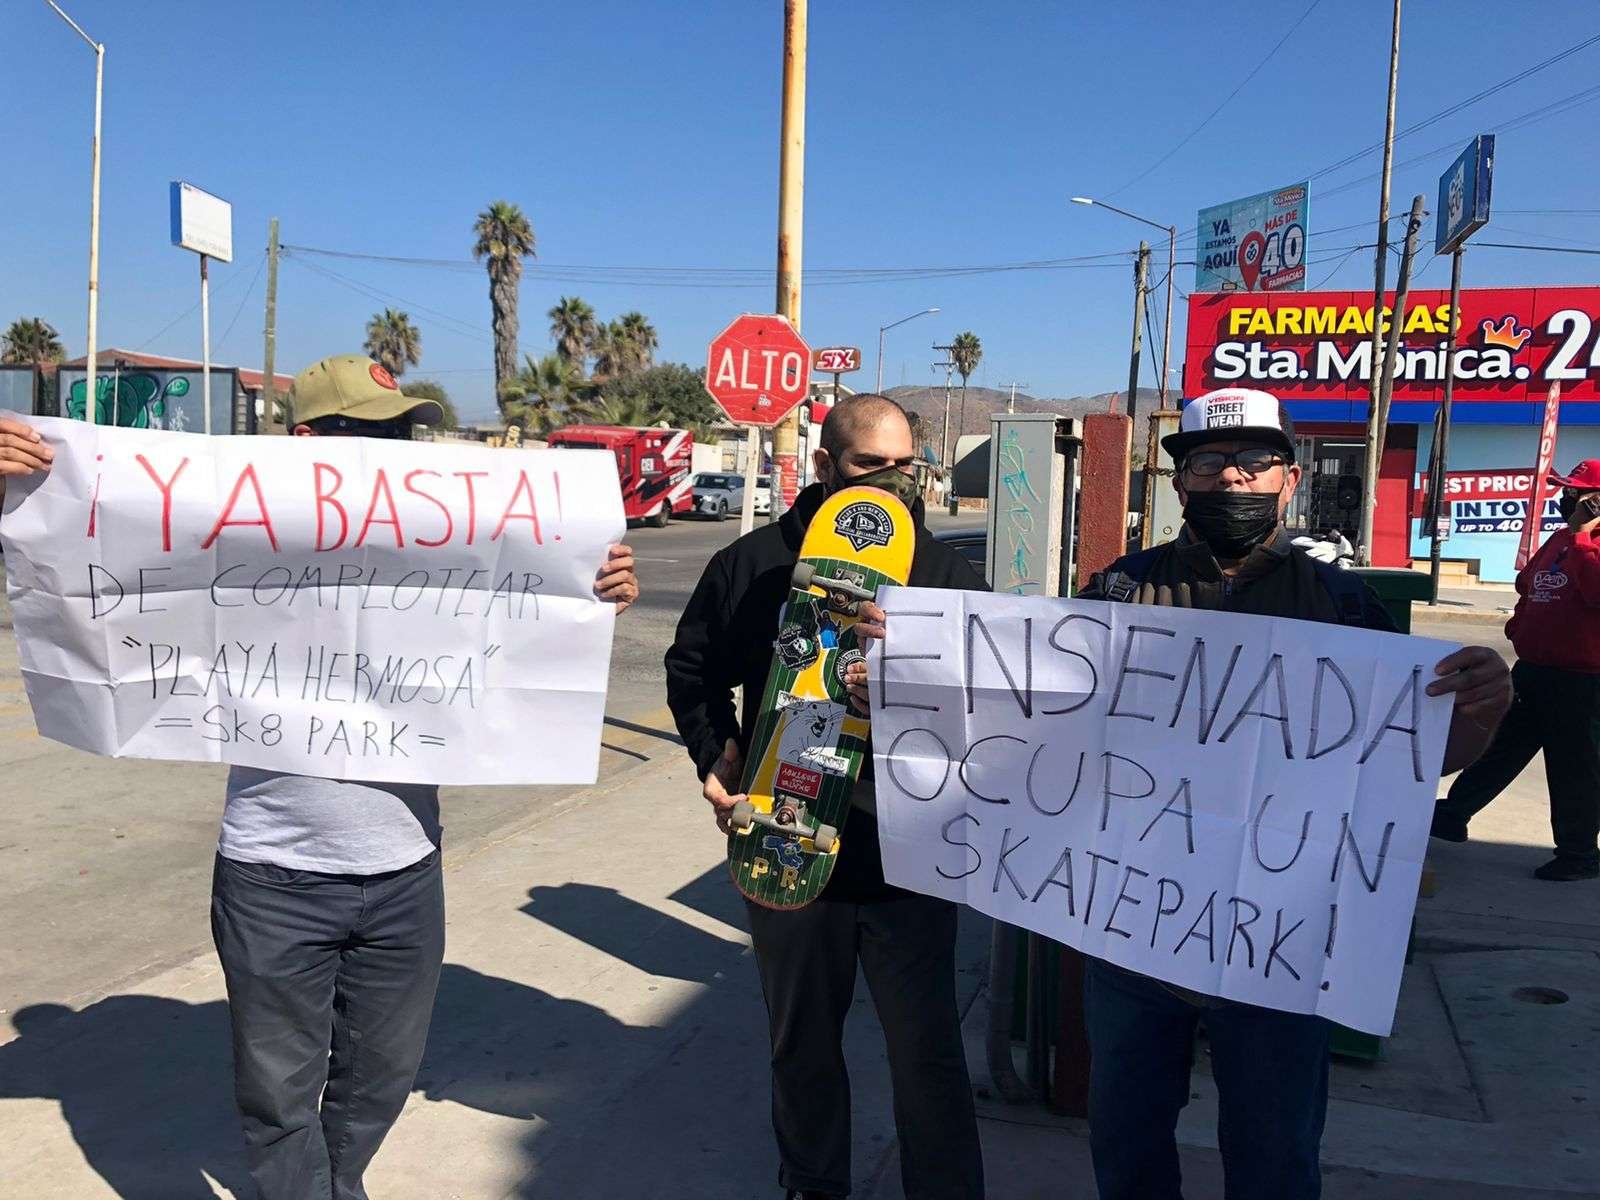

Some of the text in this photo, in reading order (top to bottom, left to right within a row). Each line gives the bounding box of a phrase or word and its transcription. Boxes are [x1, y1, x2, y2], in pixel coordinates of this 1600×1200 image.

[1213, 220, 1230, 236] YA
[1265, 210, 1297, 231] MÁS DE
[1206, 236, 1236, 249] ESTAMOS
[1260, 224, 1304, 276] 40
[1203, 246, 1238, 271] AQUÍ
[1269, 269, 1304, 288] FARMACIAS
[1229, 305, 1461, 335] FARMACAS
[1213, 341, 1309, 379] Sta.
[1545, 310, 1600, 380] 2
[714, 347, 802, 392] ALTO
[1207, 402, 1245, 415] STREET
[1209, 414, 1242, 428] WEAR
[314, 462, 564, 553] BASTA!
[1456, 501, 1481, 518] IN
[1460, 524, 1476, 532] UP
[1478, 523, 1494, 532] TO
[86, 563, 544, 621] DE COMPLOTEAR
[880, 610, 1425, 782] ENSENADA
[886, 727, 1395, 893] OCUPA UN
[935, 812, 1338, 991] SKATEPARK!
